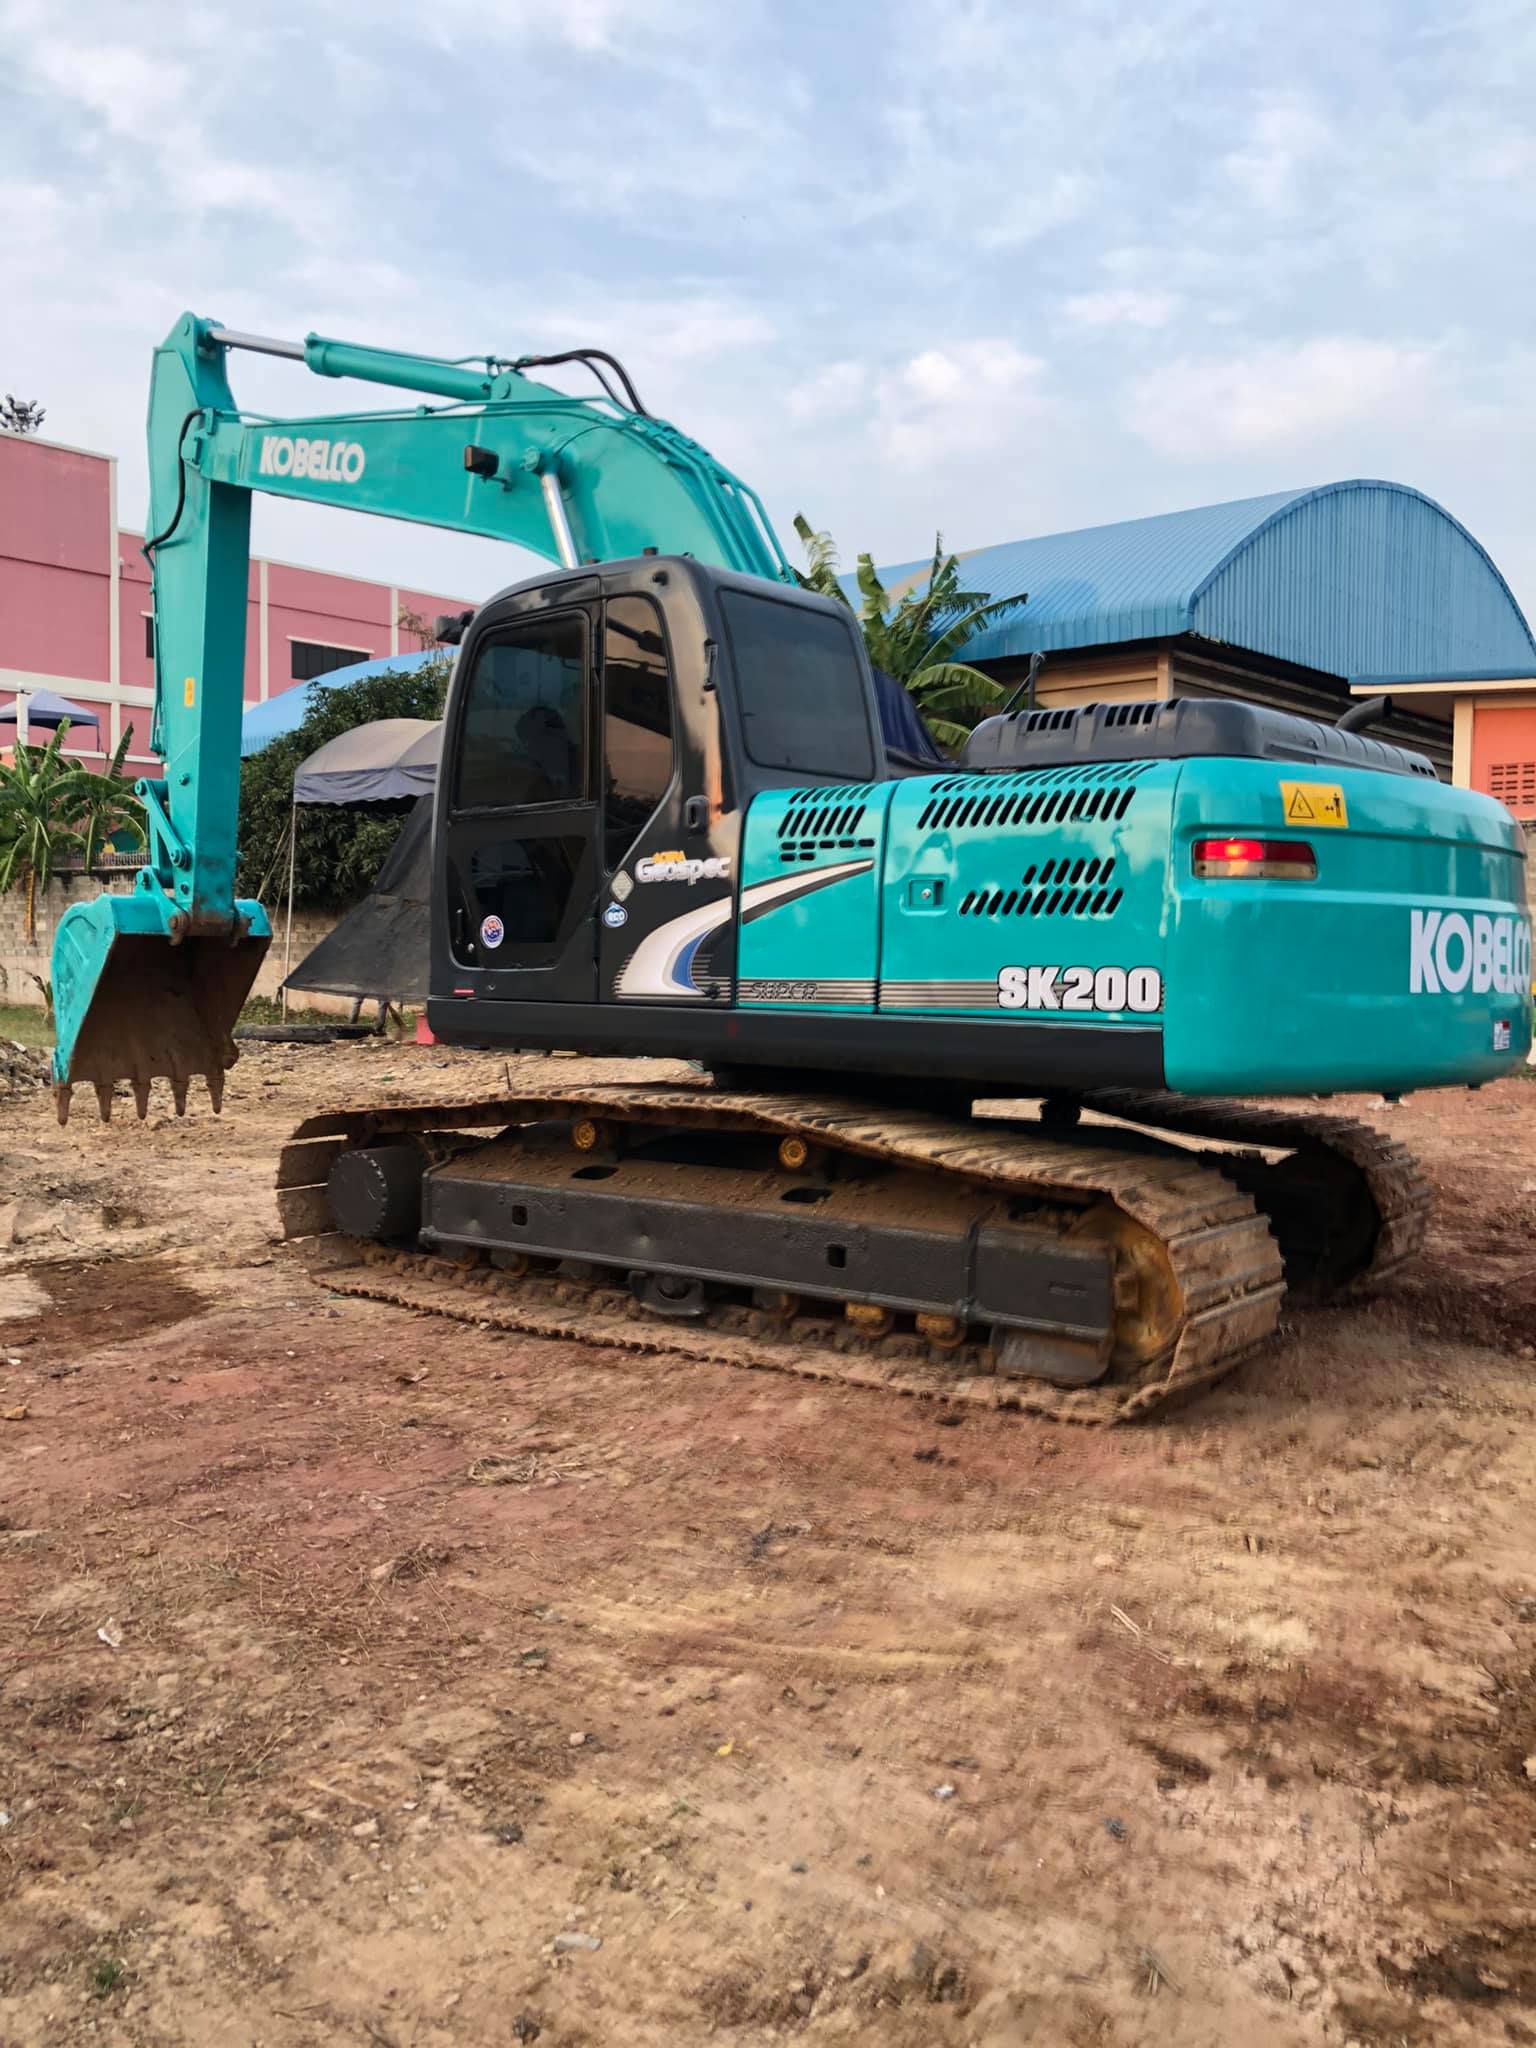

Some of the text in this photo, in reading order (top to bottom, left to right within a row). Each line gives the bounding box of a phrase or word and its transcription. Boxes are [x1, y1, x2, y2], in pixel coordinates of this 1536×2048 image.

[260, 437, 365, 482] KOBELCO
[1409, 909, 1531, 994] KOBELCO
[998, 965, 1162, 1012] SK200
